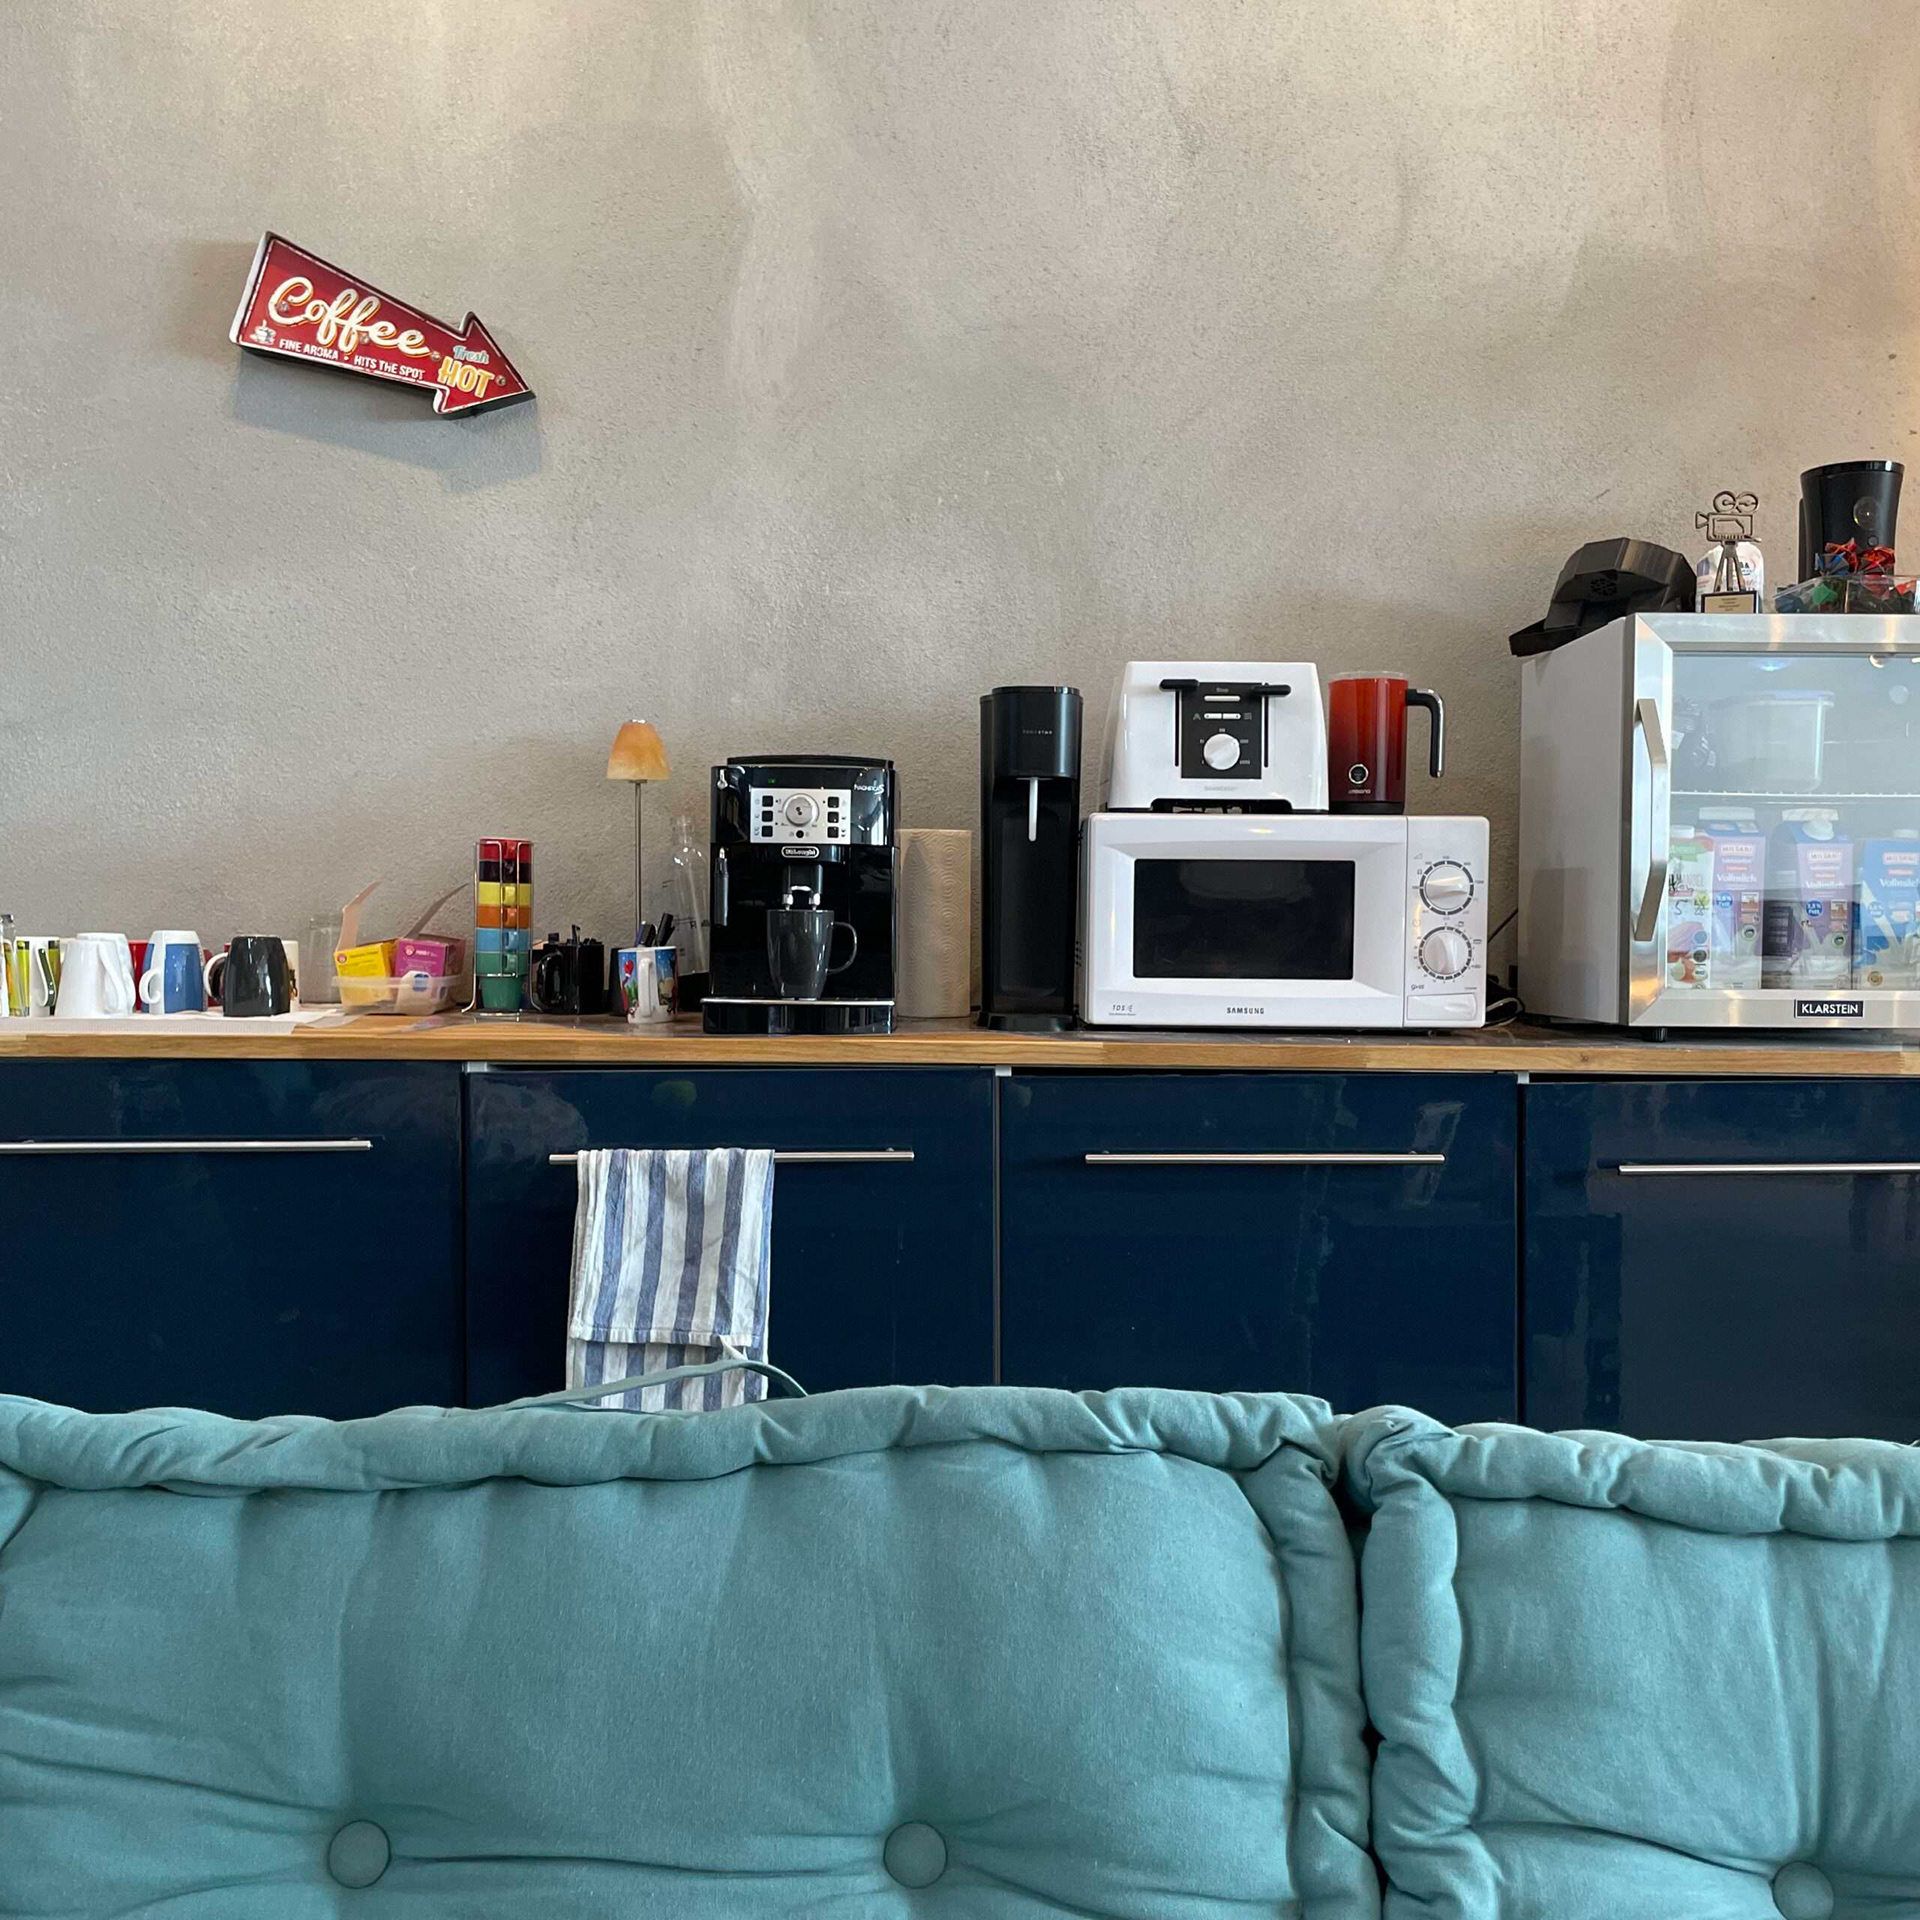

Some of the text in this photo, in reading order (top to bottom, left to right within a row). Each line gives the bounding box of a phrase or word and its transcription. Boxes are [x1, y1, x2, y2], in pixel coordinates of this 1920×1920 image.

[268, 276, 432, 358] Coffee
[279, 338, 426, 380] FINE AROMA HITS THE SPOT
[453, 345, 489, 364] Fresh
[437, 356, 495, 398] HOT
[1716, 873, 1757, 883] Vollmilch
[1226, 1007, 1265, 1015] SAMSUNG
[1801, 1003, 1859, 1014] KLARSTEIN
